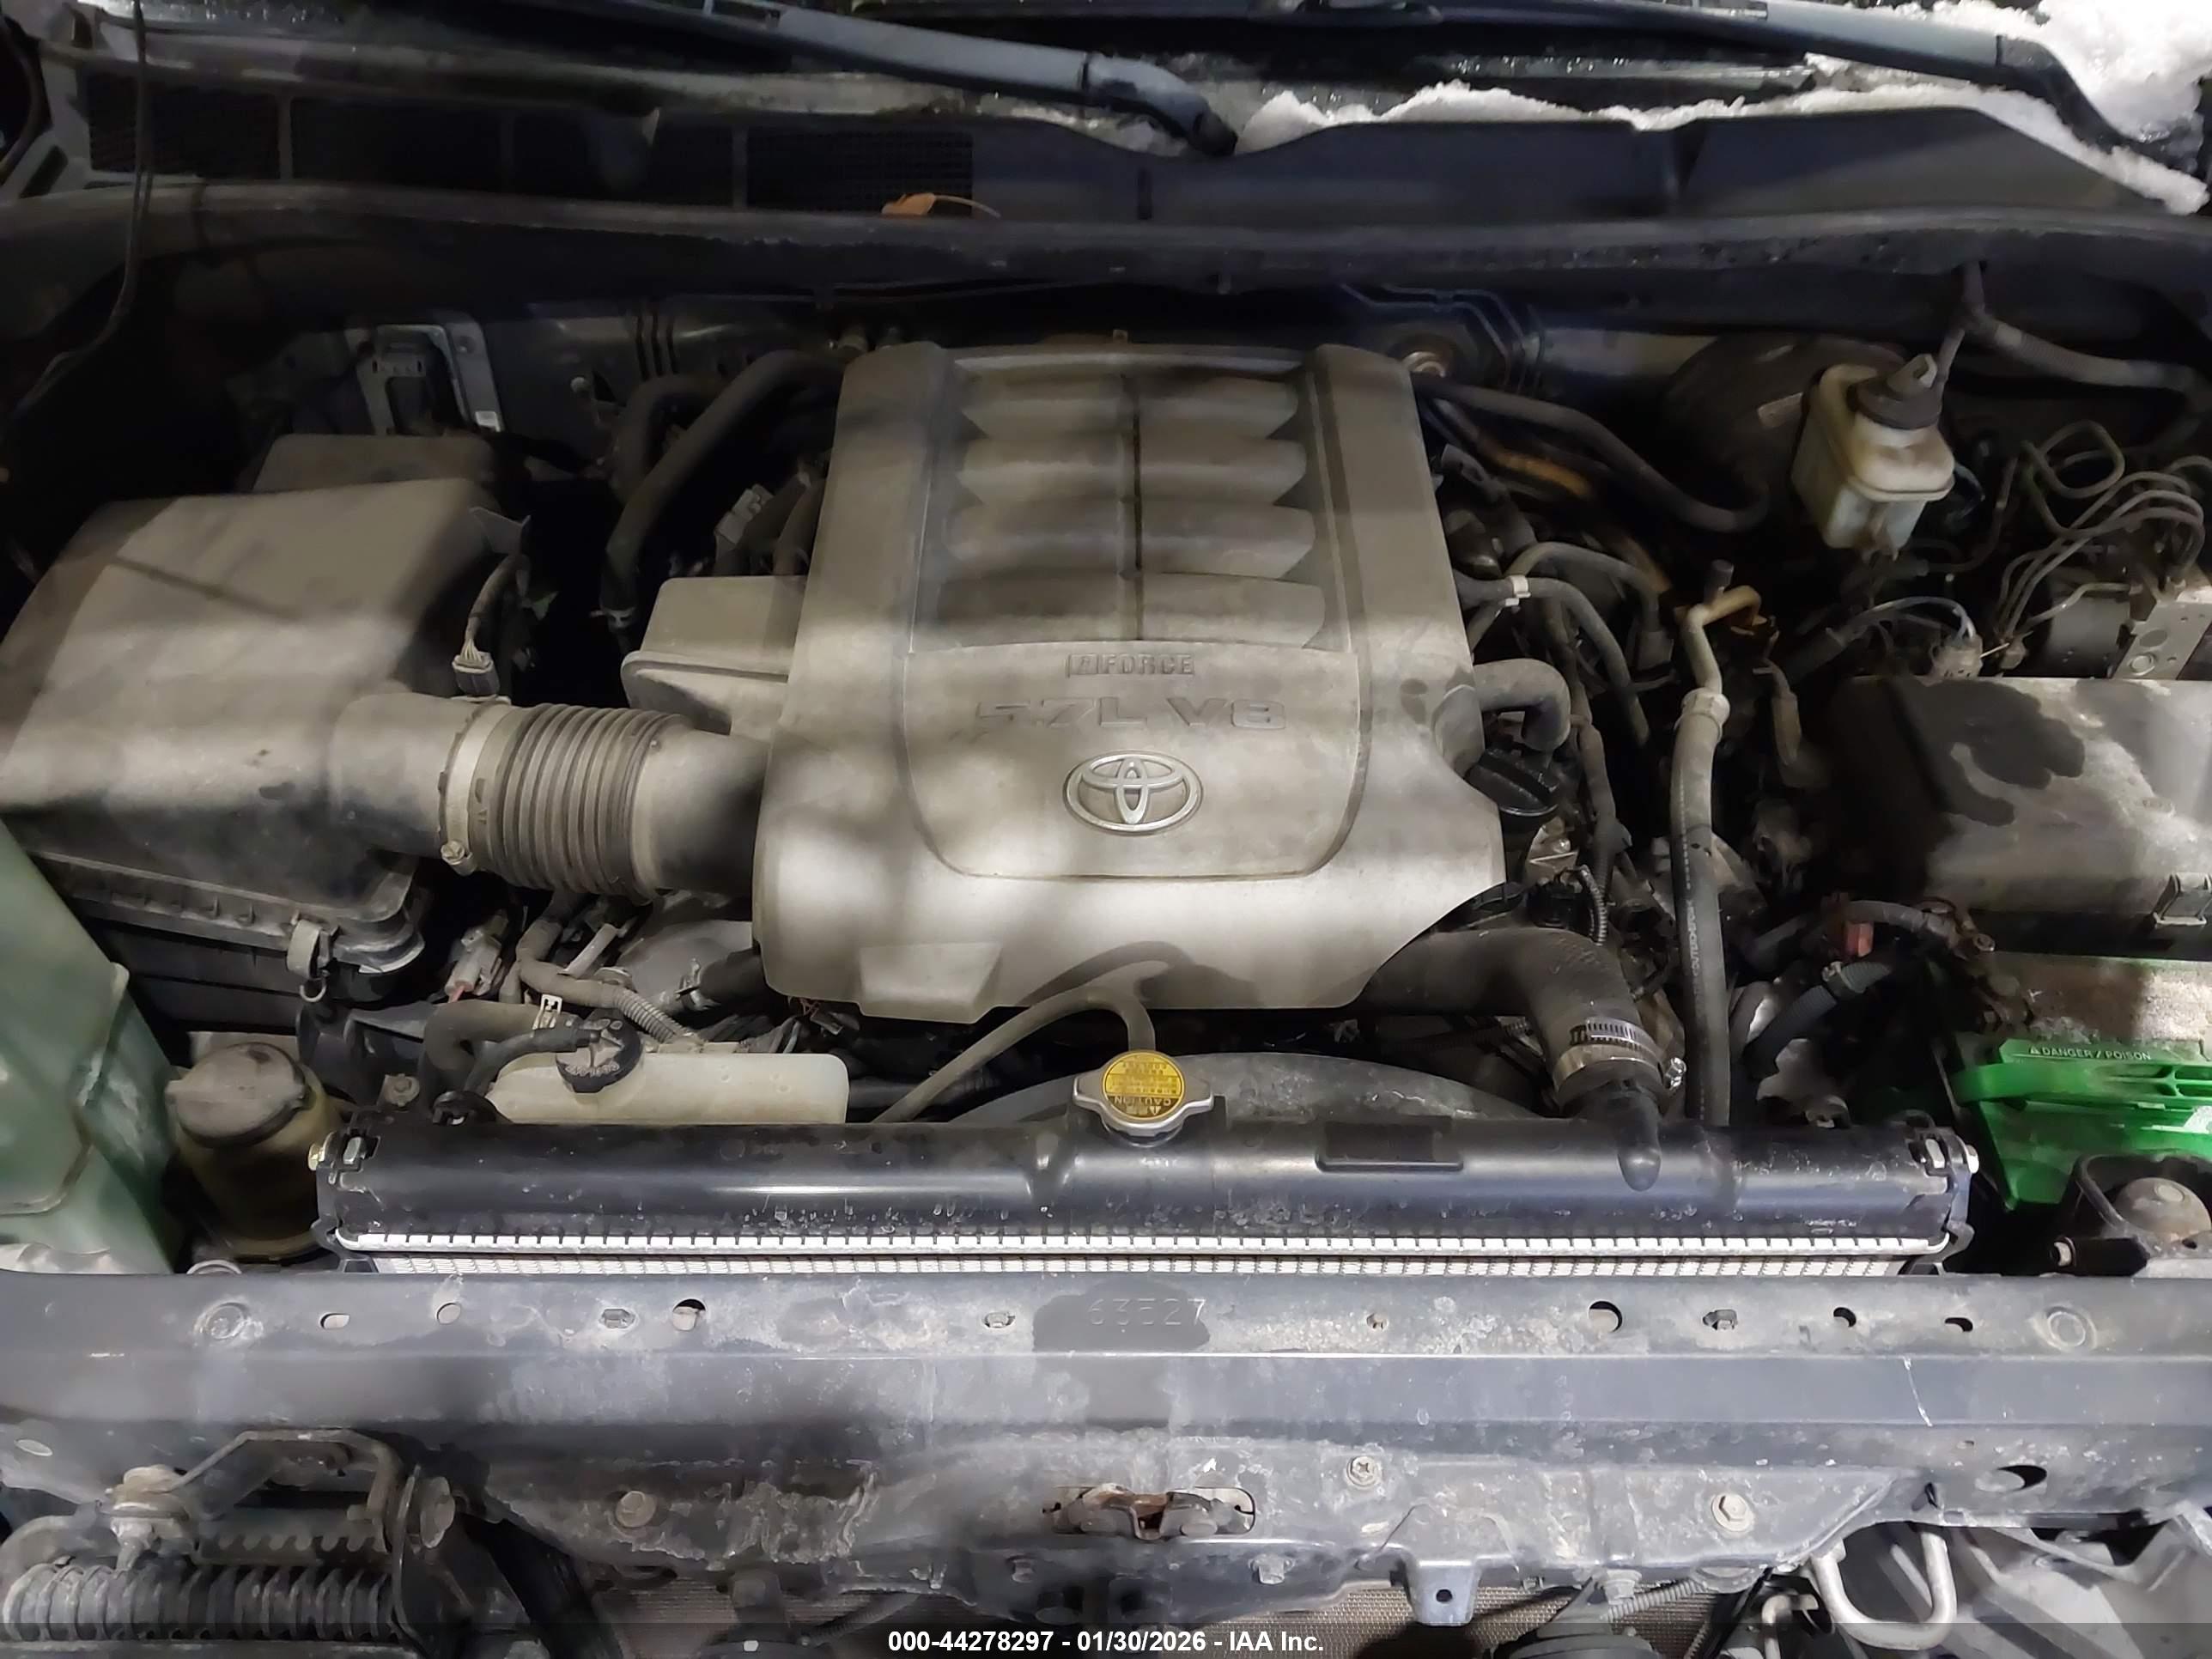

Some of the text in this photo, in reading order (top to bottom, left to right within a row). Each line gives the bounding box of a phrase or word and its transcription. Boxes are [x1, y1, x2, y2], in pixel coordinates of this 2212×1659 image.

[1166, 696, 1287, 730] V8
[2042, 1047, 2094, 1058] DANGER
[2105, 1050, 2152, 1060] POISON
